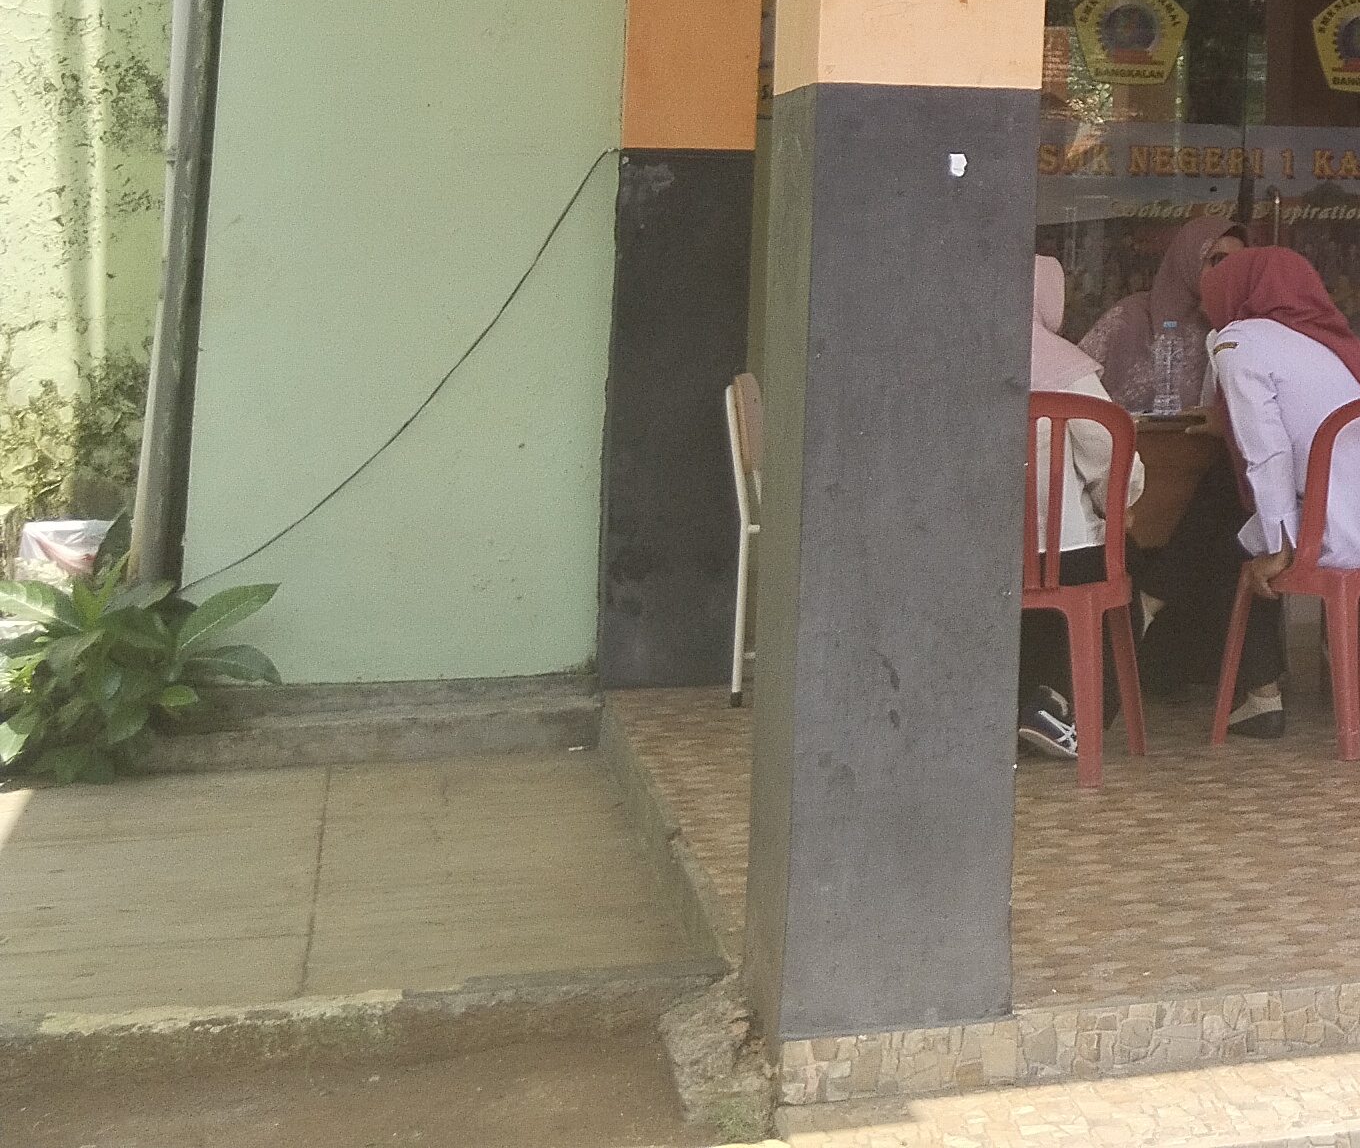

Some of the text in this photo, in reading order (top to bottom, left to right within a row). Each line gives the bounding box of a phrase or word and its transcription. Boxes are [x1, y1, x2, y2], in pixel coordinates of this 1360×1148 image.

[1038, 143, 1115, 175] SMK
[1128, 144, 1264, 178] NEGERI
[1281, 148, 1295, 179] 1
